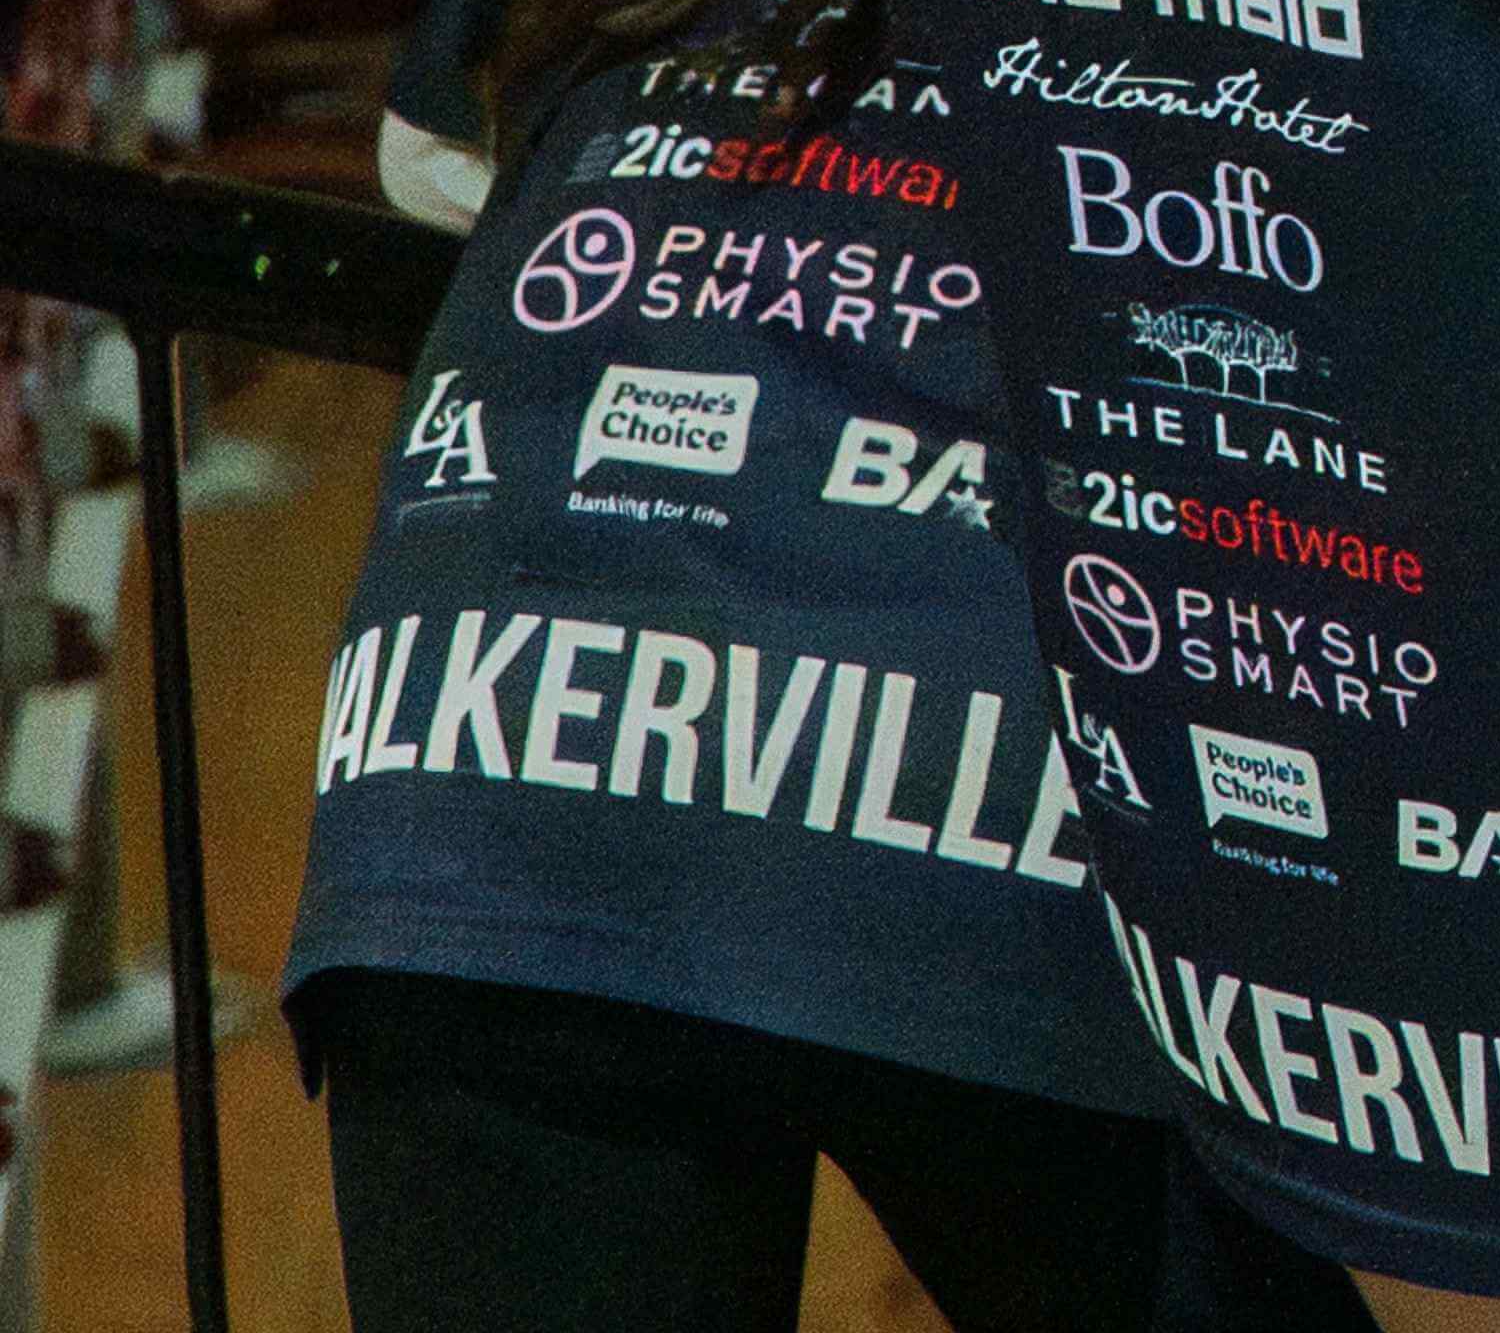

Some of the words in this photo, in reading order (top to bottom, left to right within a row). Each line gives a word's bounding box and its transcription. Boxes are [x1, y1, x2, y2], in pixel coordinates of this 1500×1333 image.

[1056, 144, 1325, 293] Boffo
[657, 225, 981, 310] PHYSIO
[641, 274, 942, 350] SMART
[601, 410, 729, 452] Choice
[612, 381, 737, 415] People's
[1047, 386, 1185, 447] THE
[1215, 414, 1389, 496] LANE
[1081, 470, 1425, 595] 2icsoftware
[1175, 588, 1438, 686] PHYSIO
[1181, 638, 1422, 730] SMART
[1206, 741, 1306, 786] People's
[1212, 771, 1312, 820] Choice
